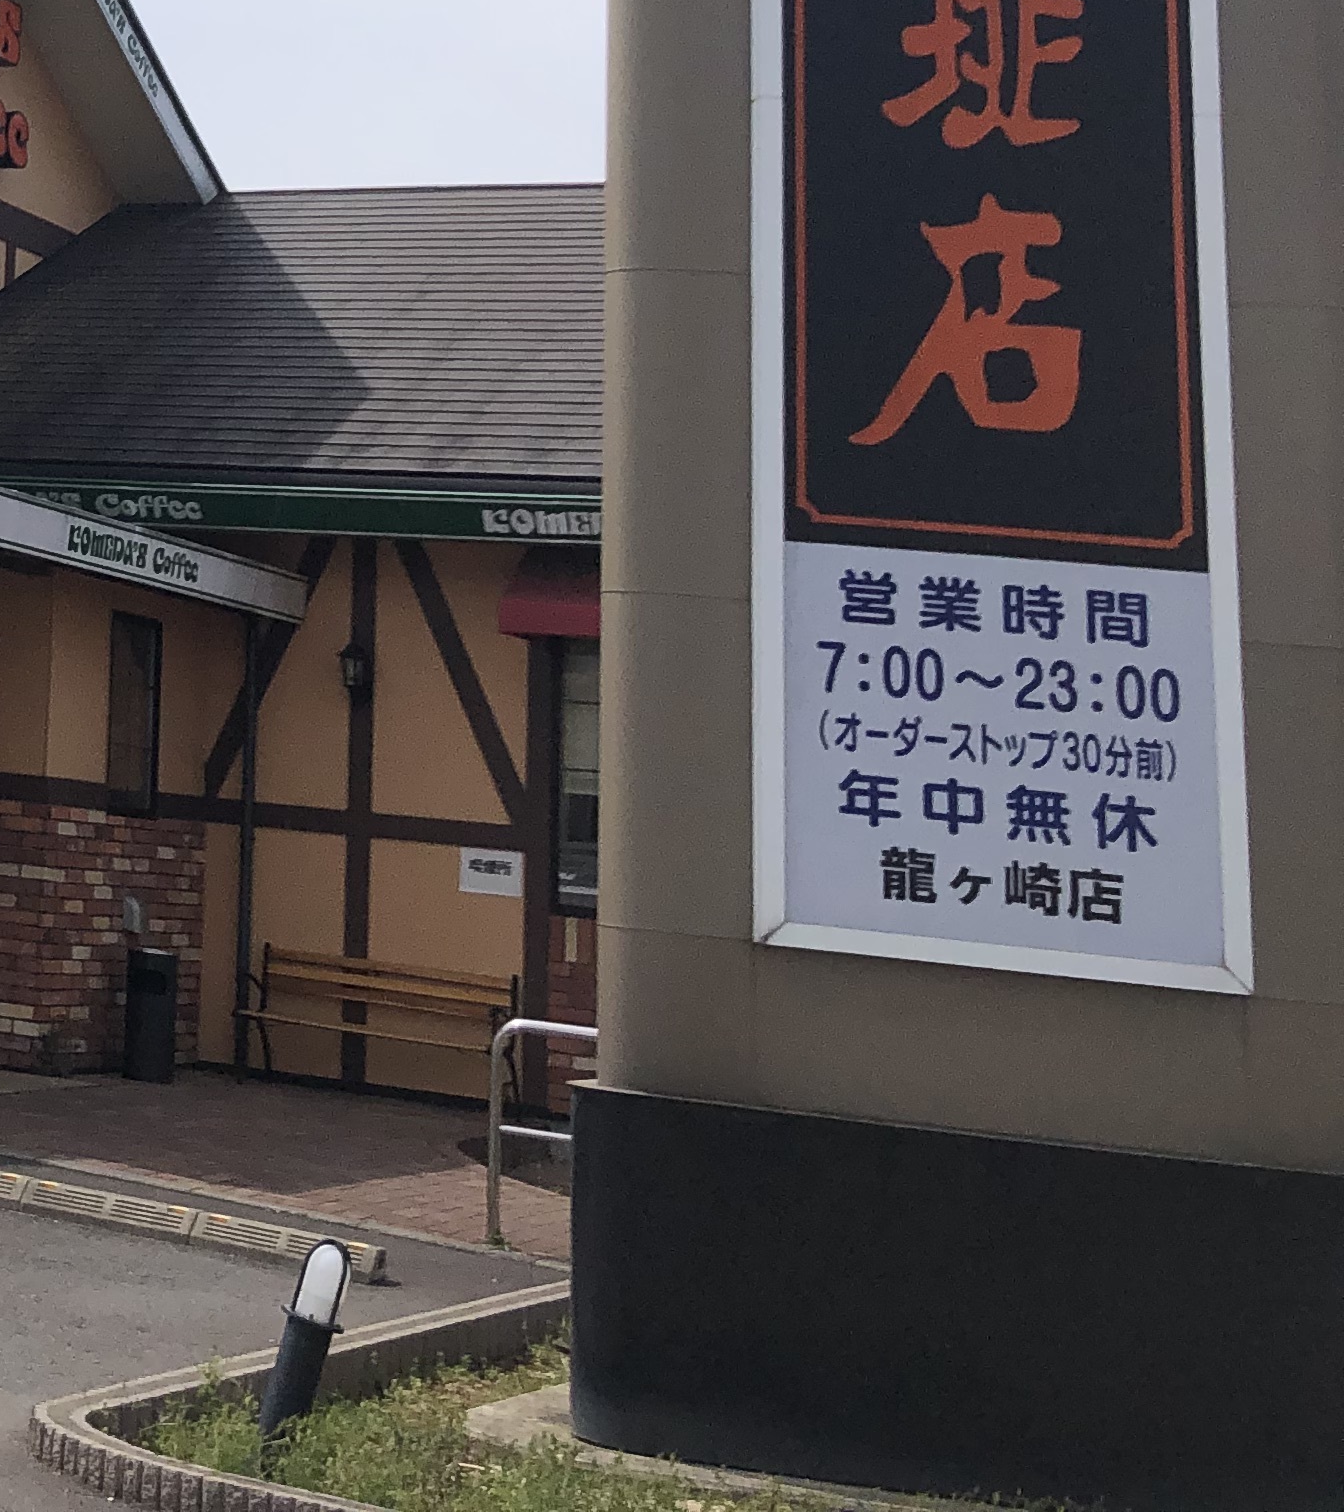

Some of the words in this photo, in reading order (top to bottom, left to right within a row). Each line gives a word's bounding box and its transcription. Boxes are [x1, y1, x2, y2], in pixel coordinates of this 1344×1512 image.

[95, 492, 204, 520] Coffee
[67, 524, 148, 569] KOMEDA'S
[153, 548, 199, 583] Coffee
[838, 568, 1151, 649] 営業時間
[819, 708, 1178, 783] (オーダーストップ30分前)
[838, 770, 1159, 853] 年中無休
